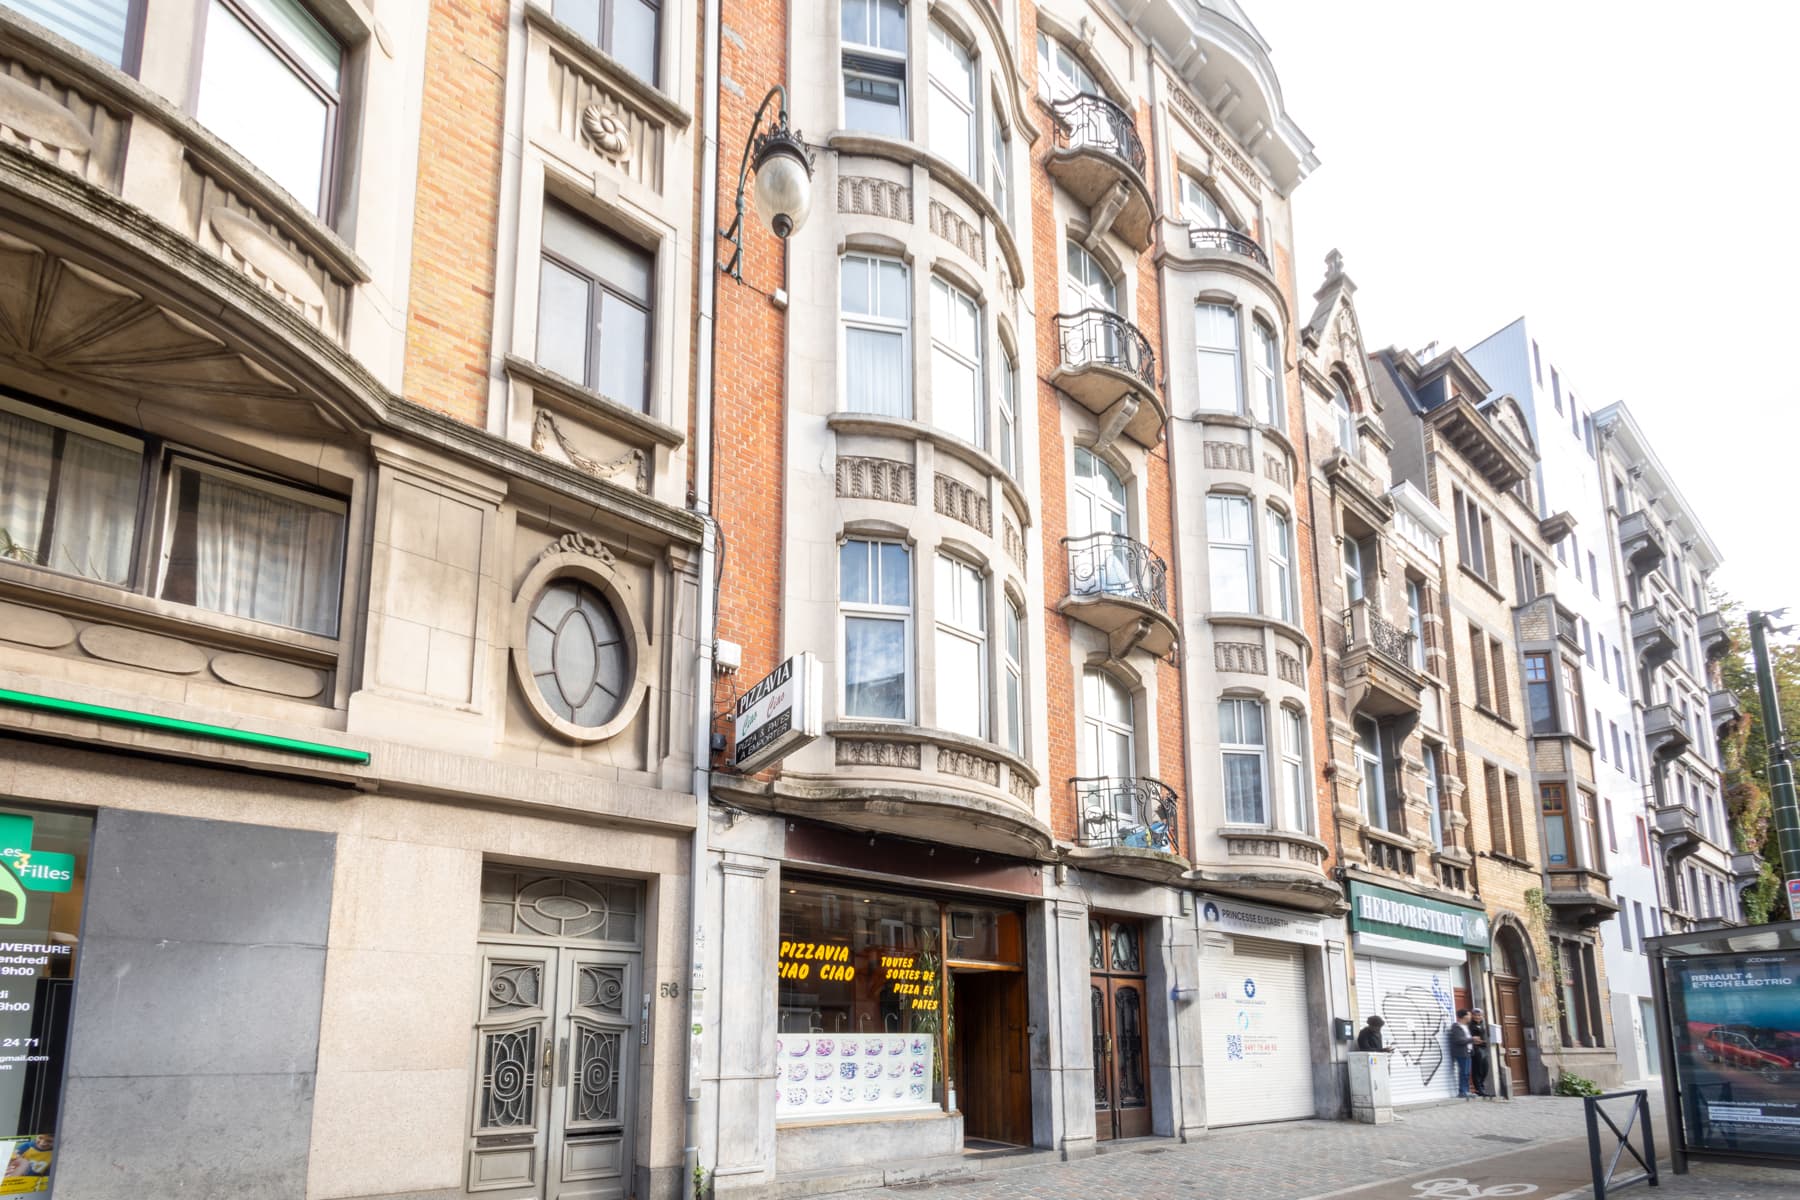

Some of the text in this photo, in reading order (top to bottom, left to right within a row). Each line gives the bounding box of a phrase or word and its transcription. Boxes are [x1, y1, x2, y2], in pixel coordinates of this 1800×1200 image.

[740, 662, 790, 714] PIZZAVIA
[737, 734, 757, 753] PIZZA
[747, 723, 788, 756] EMPORTER
[0, 848, 23, 857] es
[13, 852, 31, 868] 3
[20, 864, 70, 880] Filles
[1221, 908, 1256, 924] PRINCESSE
[1257, 915, 1289, 929] ELISABETH
[780, 941, 849, 962] PIZZAVIA
[881, 957, 914, 969] TOUTES
[820, 963, 855, 981] CIAO
[886, 968, 935, 981] SORTES DE
[1691, 973, 1742, 981] RENAULT
[660, 982, 679, 998] 56
[893, 983, 935, 996] PIZZA ET
[1692, 978, 1793, 988] E-TECH ELECTRIC
[912, 999, 939, 1010] PATES
[3, 1038, 39, 1047] 24 71
